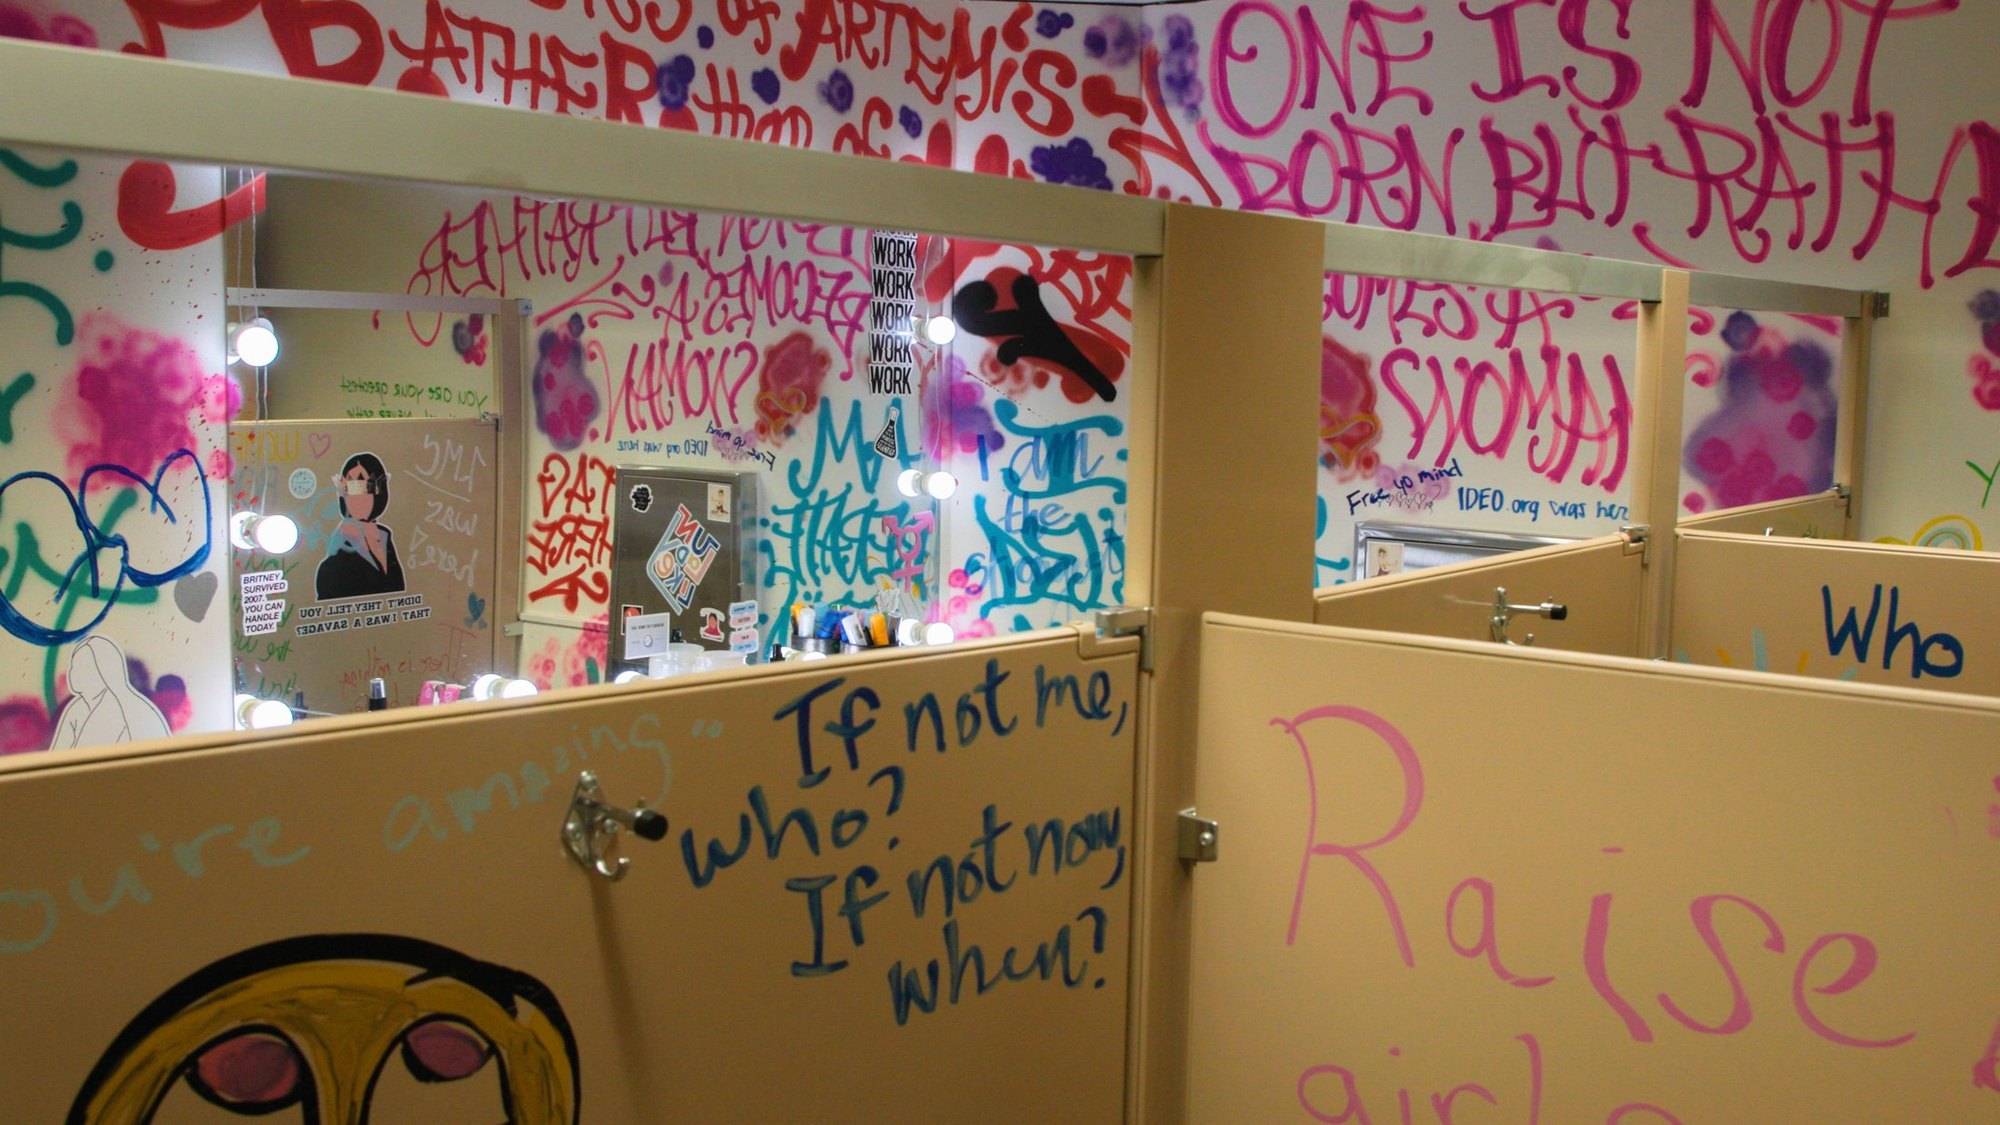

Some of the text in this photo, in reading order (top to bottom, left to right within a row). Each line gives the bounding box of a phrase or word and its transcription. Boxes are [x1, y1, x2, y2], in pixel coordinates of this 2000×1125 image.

[1211, 0, 1960, 137] ONE IS NOT
[1201, 113, 1463, 234] BORN
[874, 236, 915, 268] WORK
[873, 269, 914, 300] WORK
[872, 301, 913, 331] WORK
[871, 333, 912, 363] WORK
[870, 366, 911, 394] WORK
[1418, 458, 1463, 484] mind
[1550, 501, 1586, 519] was
[243, 573, 280, 584] BRITNEY
[244, 582, 286, 594] SURVIVED
[244, 594, 265, 604] 2007.
[245, 602, 283, 614] YOU CAN
[245, 612, 280, 624] HANDLE
[246, 622, 275, 633] TODAY.
[1821, 582, 1965, 680] Who
[773, 659, 1127, 788] If not me,
[680, 766, 904, 888] who?
[785, 804, 1126, 977] If not now,
[1269, 703, 1917, 1049] Raise
[888, 907, 1107, 1026] when?
